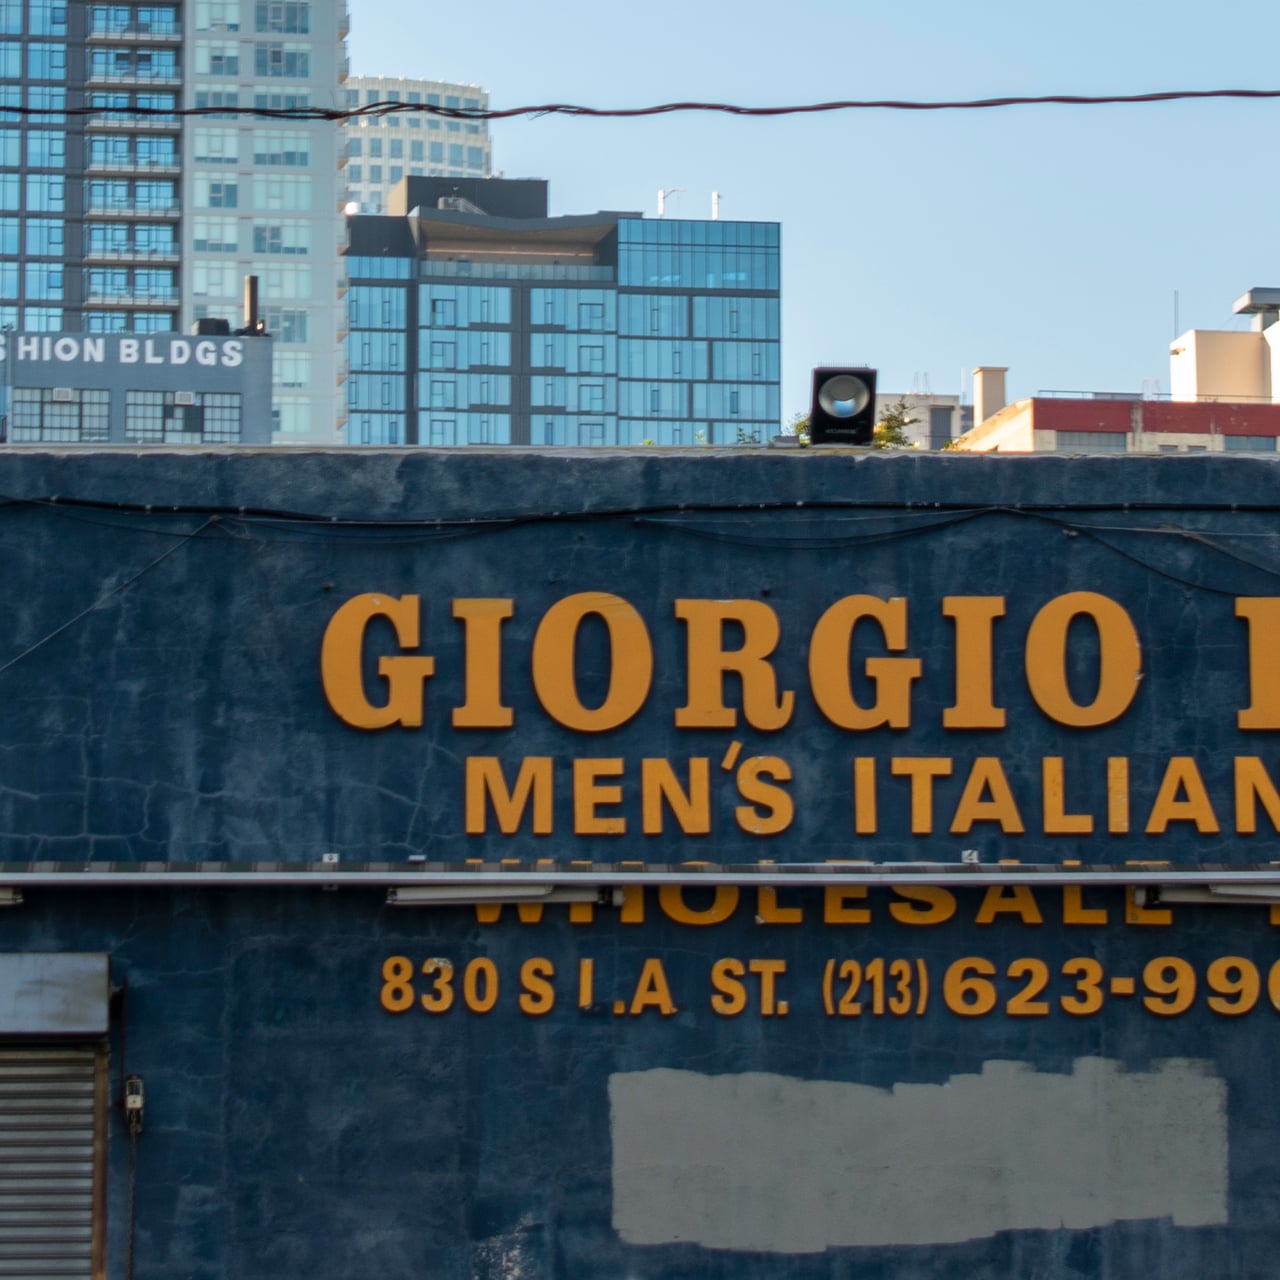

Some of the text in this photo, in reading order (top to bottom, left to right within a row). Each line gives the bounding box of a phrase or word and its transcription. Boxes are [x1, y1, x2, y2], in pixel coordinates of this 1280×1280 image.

[119, 338, 244, 368] BLDGS
[320, 591, 1143, 734] GIORGIO
[463, 740, 796, 836] MEN'S
[380, 954, 500, 1013] 830
[517, 956, 556, 1015] S
[709, 957, 790, 1017] ST.
[821, 958, 930, 1017] (213)
